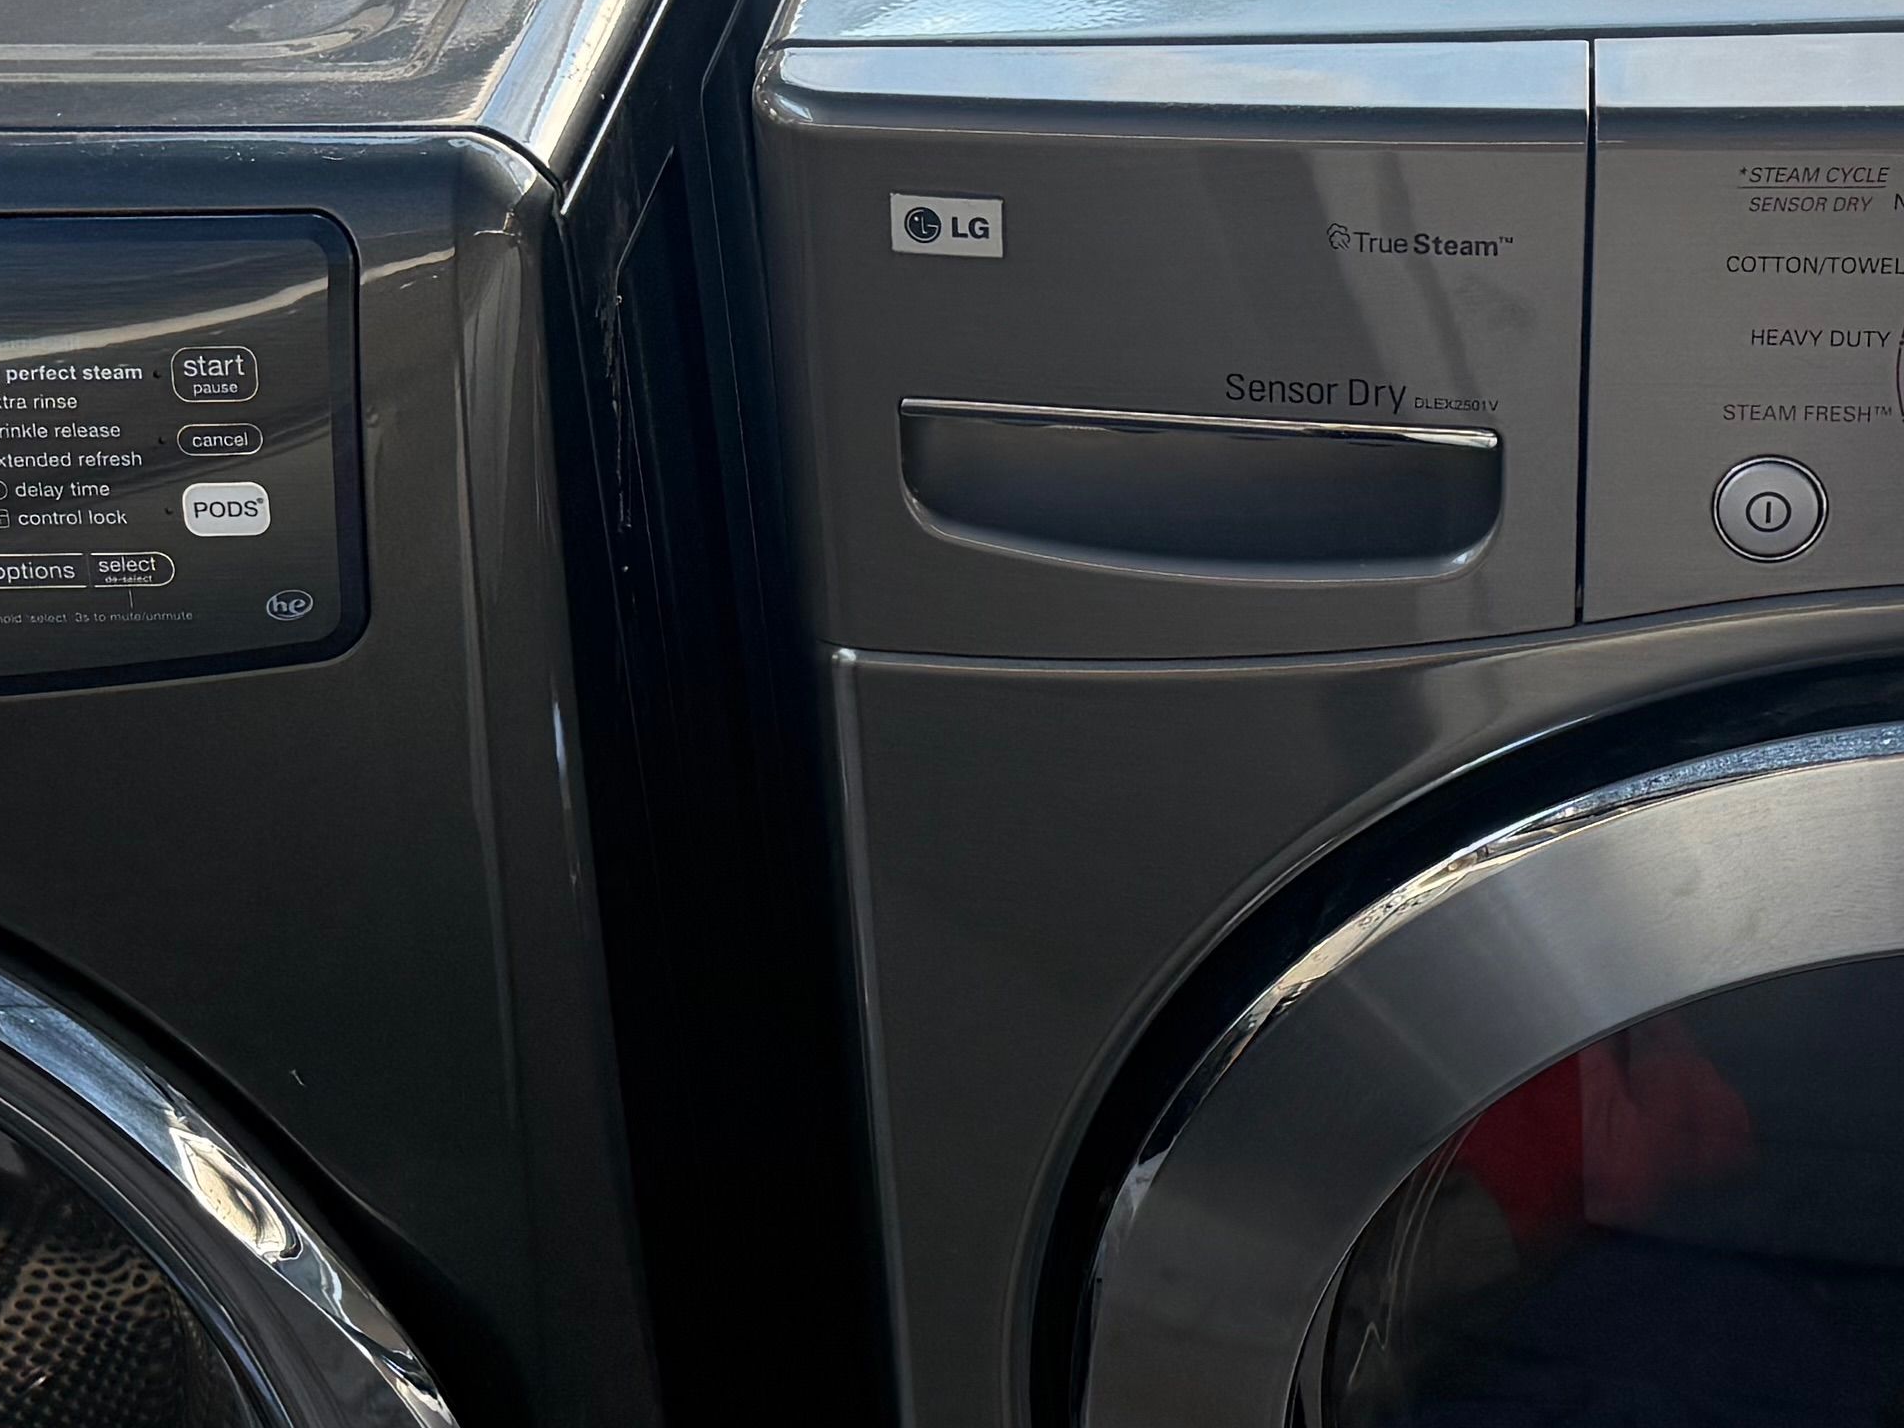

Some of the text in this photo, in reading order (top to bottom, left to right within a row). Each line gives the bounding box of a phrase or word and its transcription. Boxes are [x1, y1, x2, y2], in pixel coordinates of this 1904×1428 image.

[1825, 165, 1891, 185] CYCLE
[1748, 195, 1873, 214] SENSOR DRY
[950, 215, 991, 240] LG
[1750, 328, 1892, 349] HEAVY DUTY
[5, 365, 143, 384] perfect steam
[182, 354, 245, 378] start
[193, 382, 238, 397] pause
[1224, 372, 1499, 415] Sensor Dry DLEX2501V
[32, 393, 78, 409] rinse
[1722, 404, 1797, 423] STEAM
[54, 422, 121, 438] release
[192, 432, 249, 448] cancel
[78, 450, 143, 467] refresh
[14, 481, 111, 501] delay time
[18, 509, 128, 526] control lock
[97, 555, 157, 573] select
[93, 612, 107, 622] to
[109, 611, 194, 623] mute/unmute
